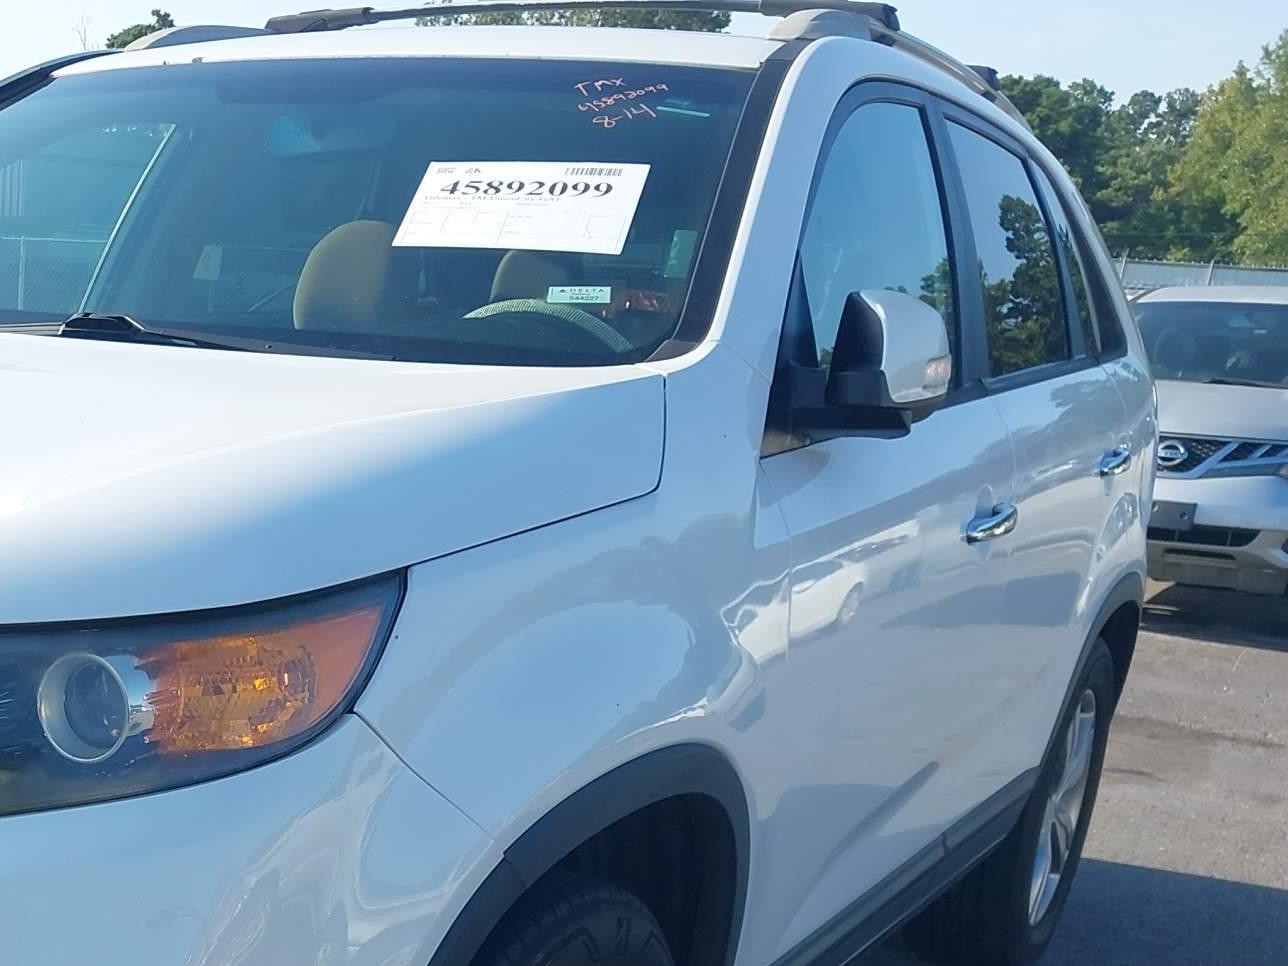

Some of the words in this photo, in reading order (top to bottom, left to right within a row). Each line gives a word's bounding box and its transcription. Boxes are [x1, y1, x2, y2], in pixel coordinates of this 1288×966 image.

[577, 83, 669, 112] 45892099
[592, 103, 656, 128] 8-14
[440, 180, 614, 197] 45892099
